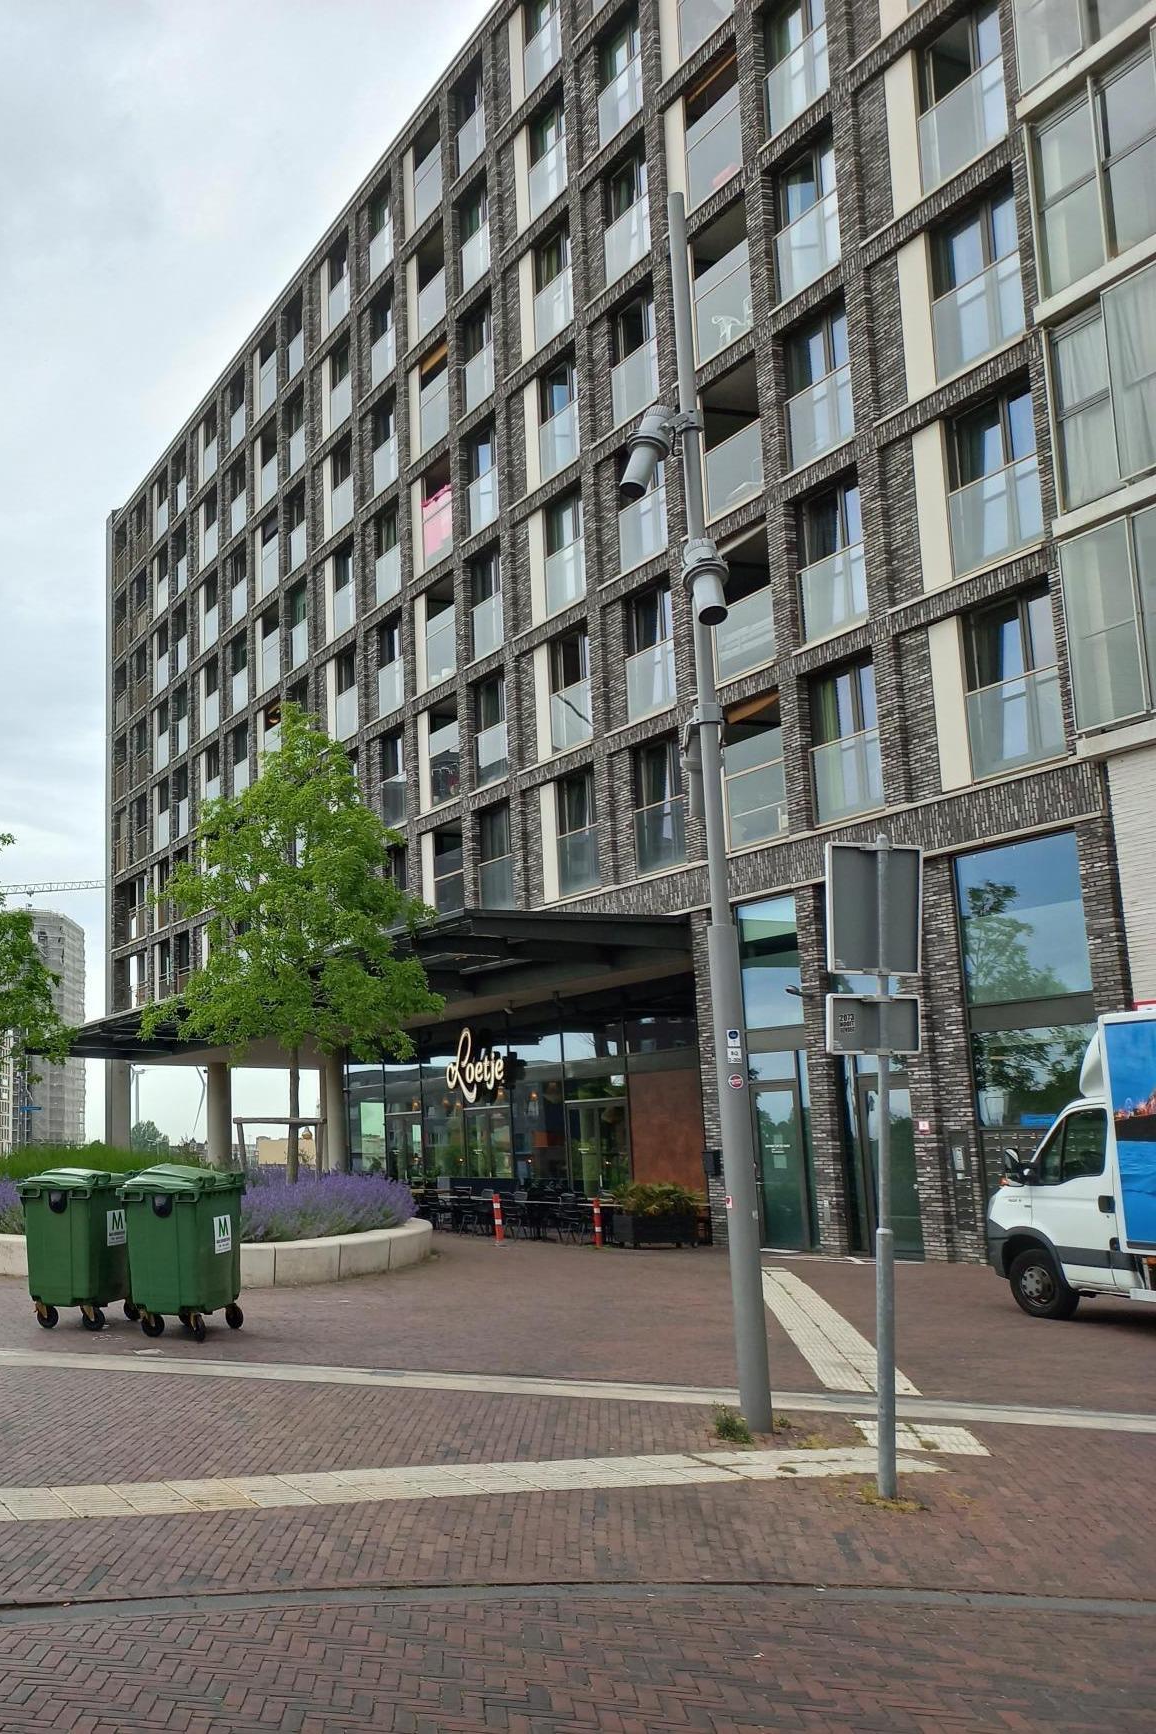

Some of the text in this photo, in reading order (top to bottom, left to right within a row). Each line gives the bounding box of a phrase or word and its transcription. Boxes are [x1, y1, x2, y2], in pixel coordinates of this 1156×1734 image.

[446, 1027, 504, 1103] Loetje
[112, 1211, 123, 1231] M
[218, 1217, 229, 1237] M
